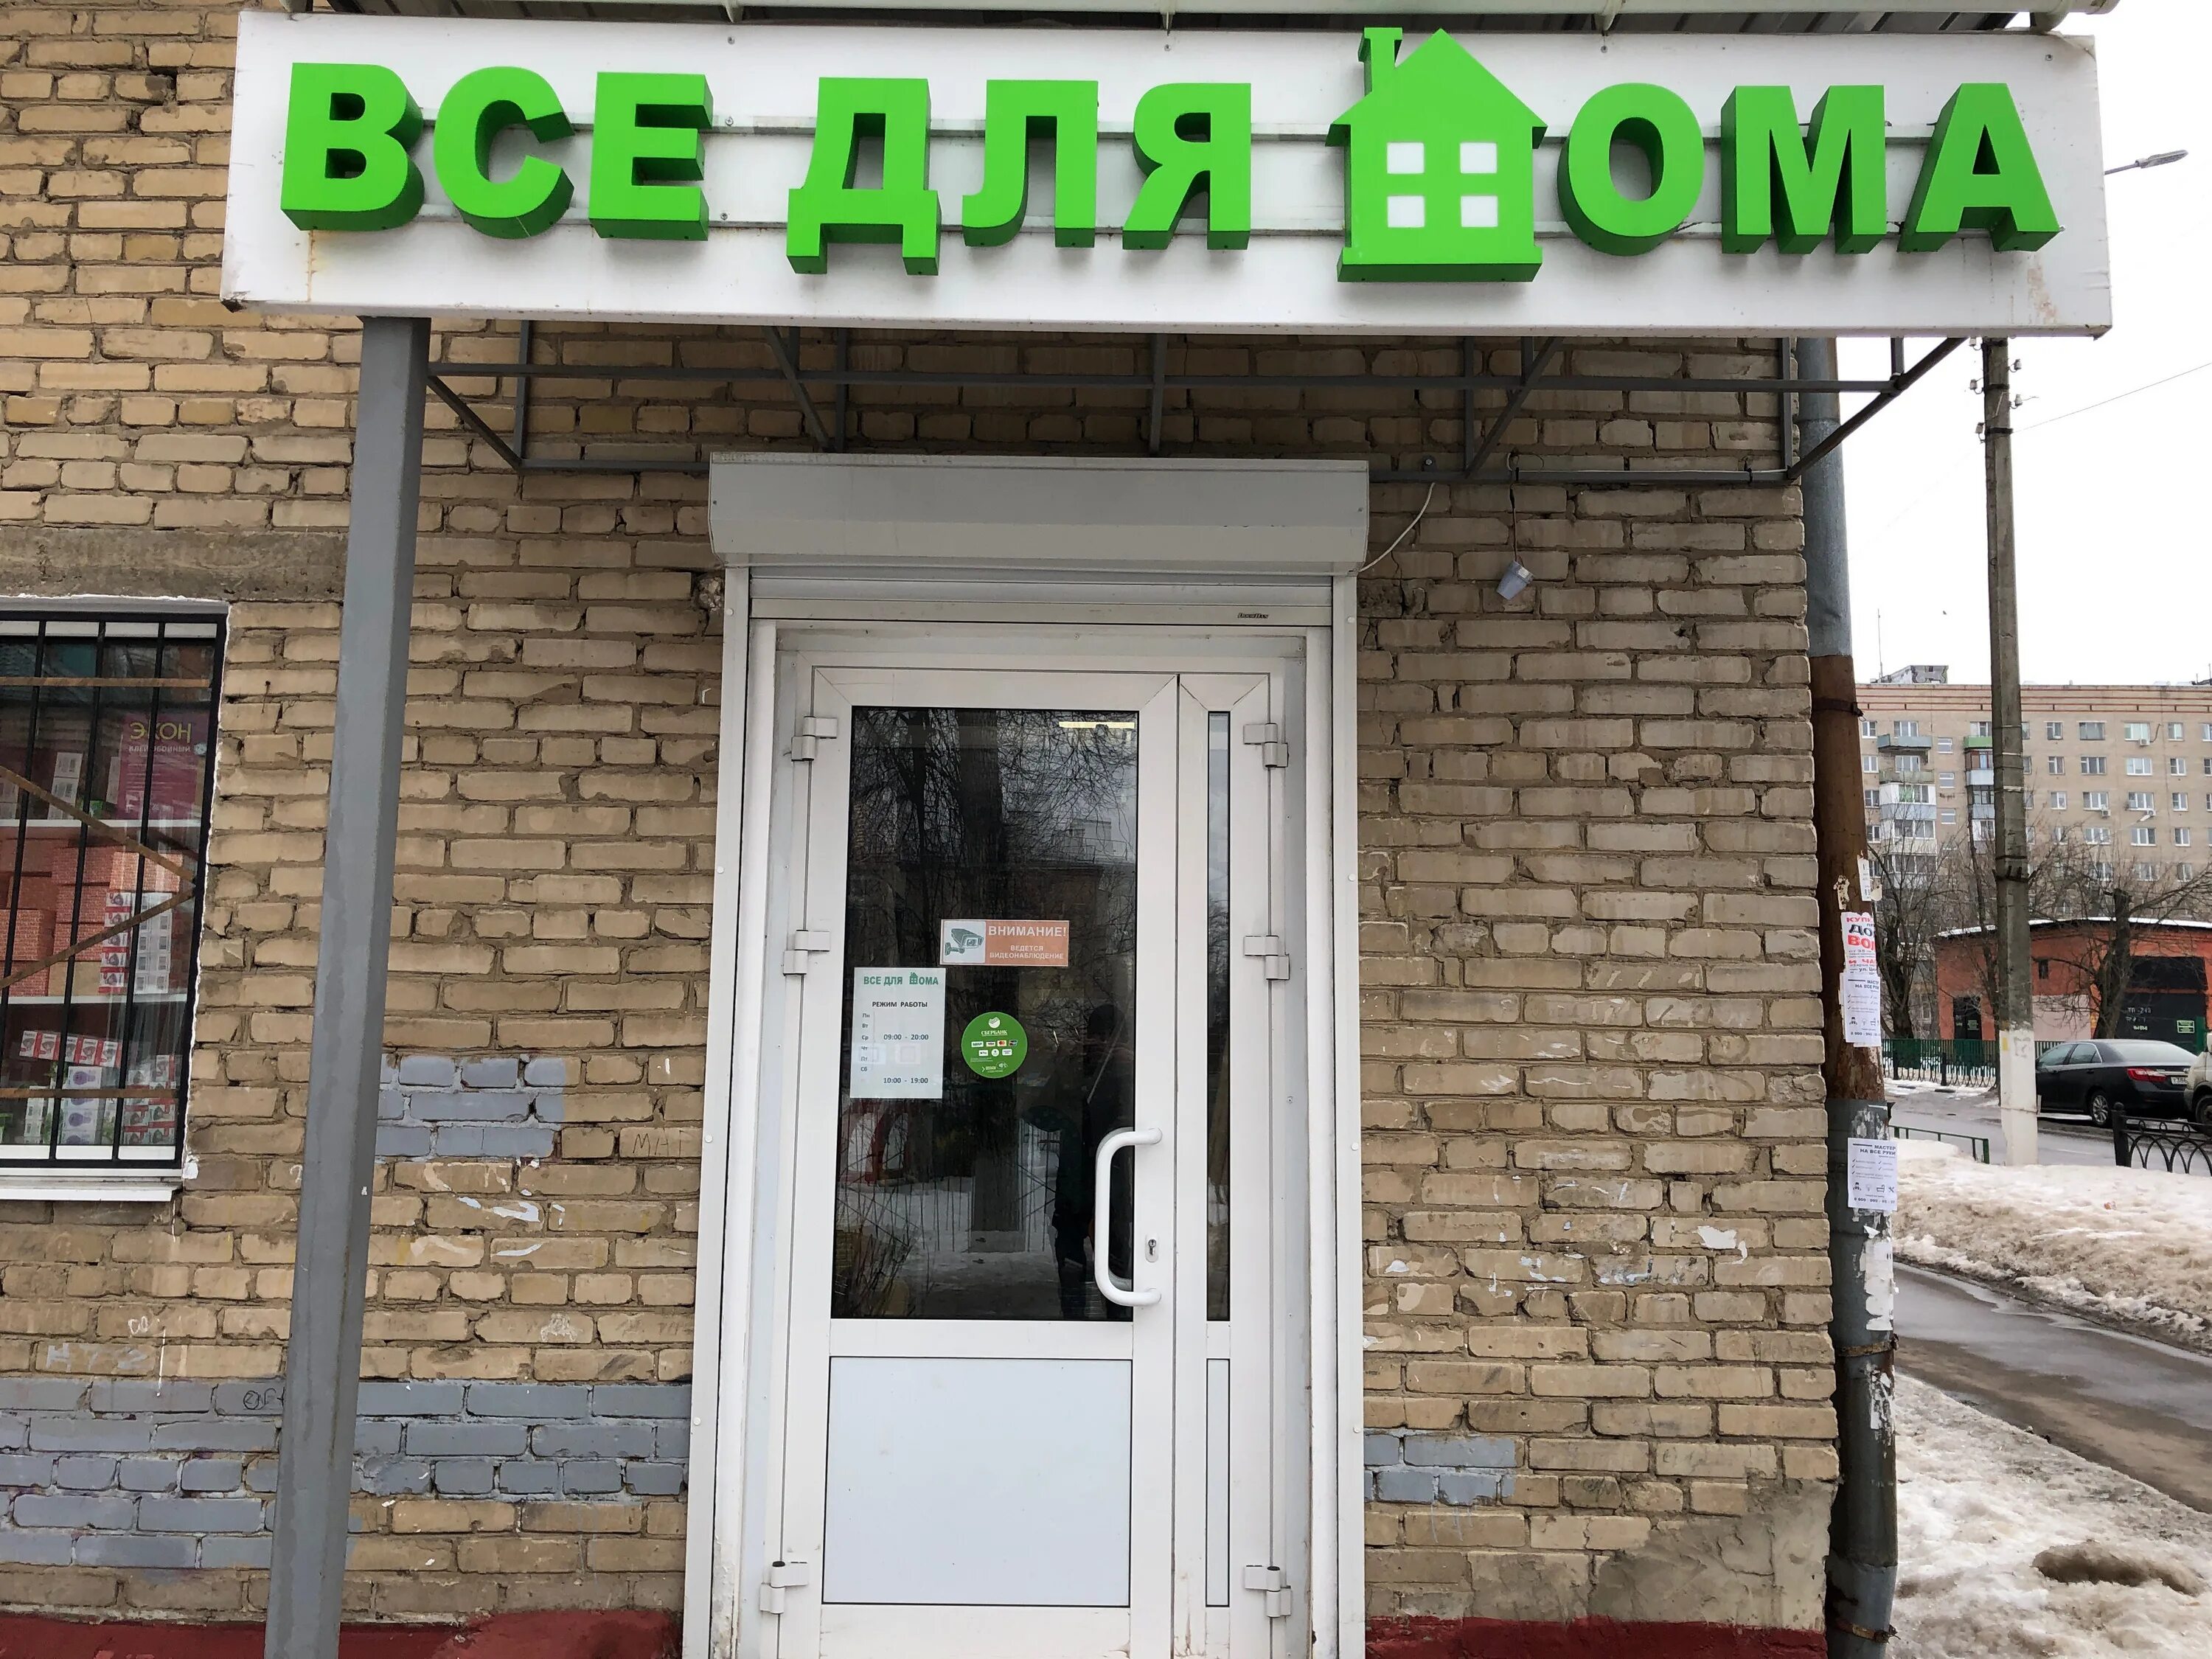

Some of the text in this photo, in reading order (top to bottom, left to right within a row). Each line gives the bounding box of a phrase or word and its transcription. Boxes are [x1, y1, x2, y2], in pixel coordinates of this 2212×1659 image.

[281, 63, 713, 241] ВСЕ
[787, 77, 1251, 276] ДЛЯ
[988, 925, 1067, 937] ВНИМАНИЕ!
[990, 952, 1064, 960] ВИДЕОНАБЛЮДЕНИЕ
[863, 976, 881, 984] ВСЕ
[883, 976, 902, 986] ДЛЯ
